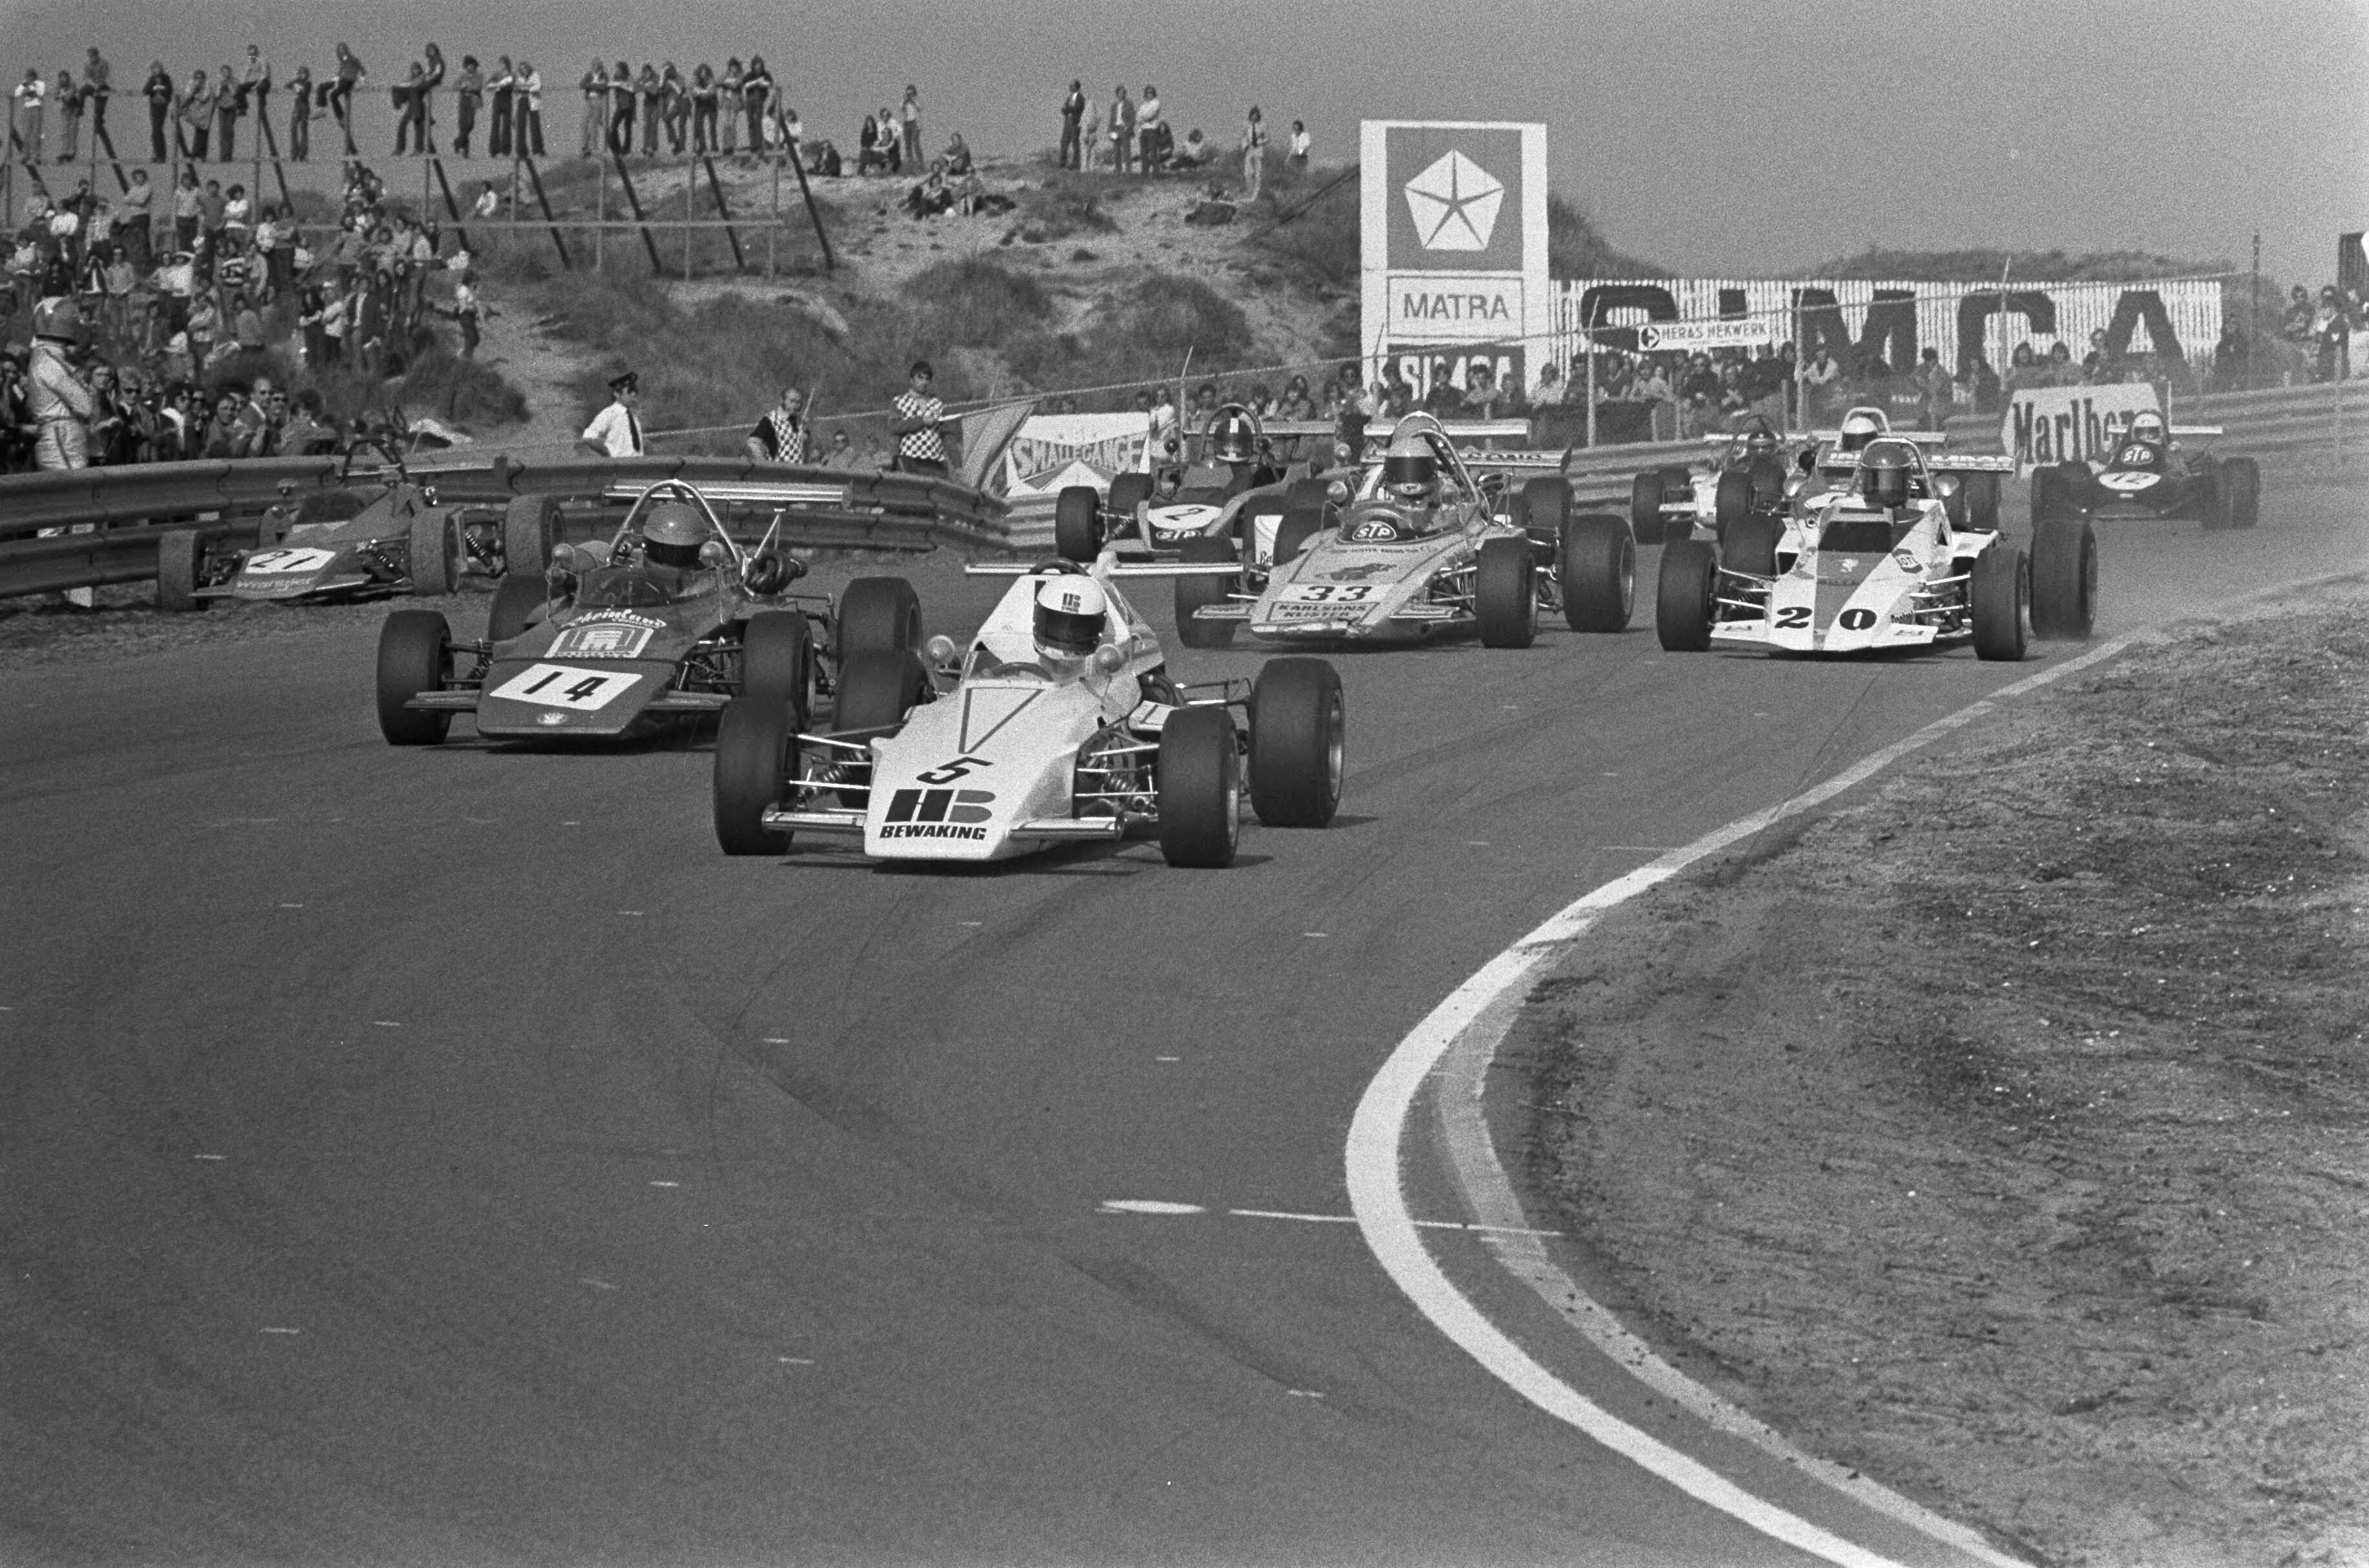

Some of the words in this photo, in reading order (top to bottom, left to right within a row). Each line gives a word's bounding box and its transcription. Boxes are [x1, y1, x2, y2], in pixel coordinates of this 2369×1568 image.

[1403, 293, 1509, 319] MATRA
[1579, 283, 2193, 374] SMCA
[1662, 326, 1703, 341] HERAS
[2013, 397, 2134, 465] Marlbo
[1010, 434, 1145, 480] SMALLEGANGE
[2125, 446, 2152, 461] STP
[1164, 507, 1206, 521] 2
[1357, 522, 1390, 537] STP
[250, 550, 317, 569] 21
[1301, 586, 1372, 601] 33
[522, 671, 610, 702] 14
[916, 757, 994, 785] 5
[884, 789, 997, 824] HB
[880, 825, 987, 840] BEWAKING
